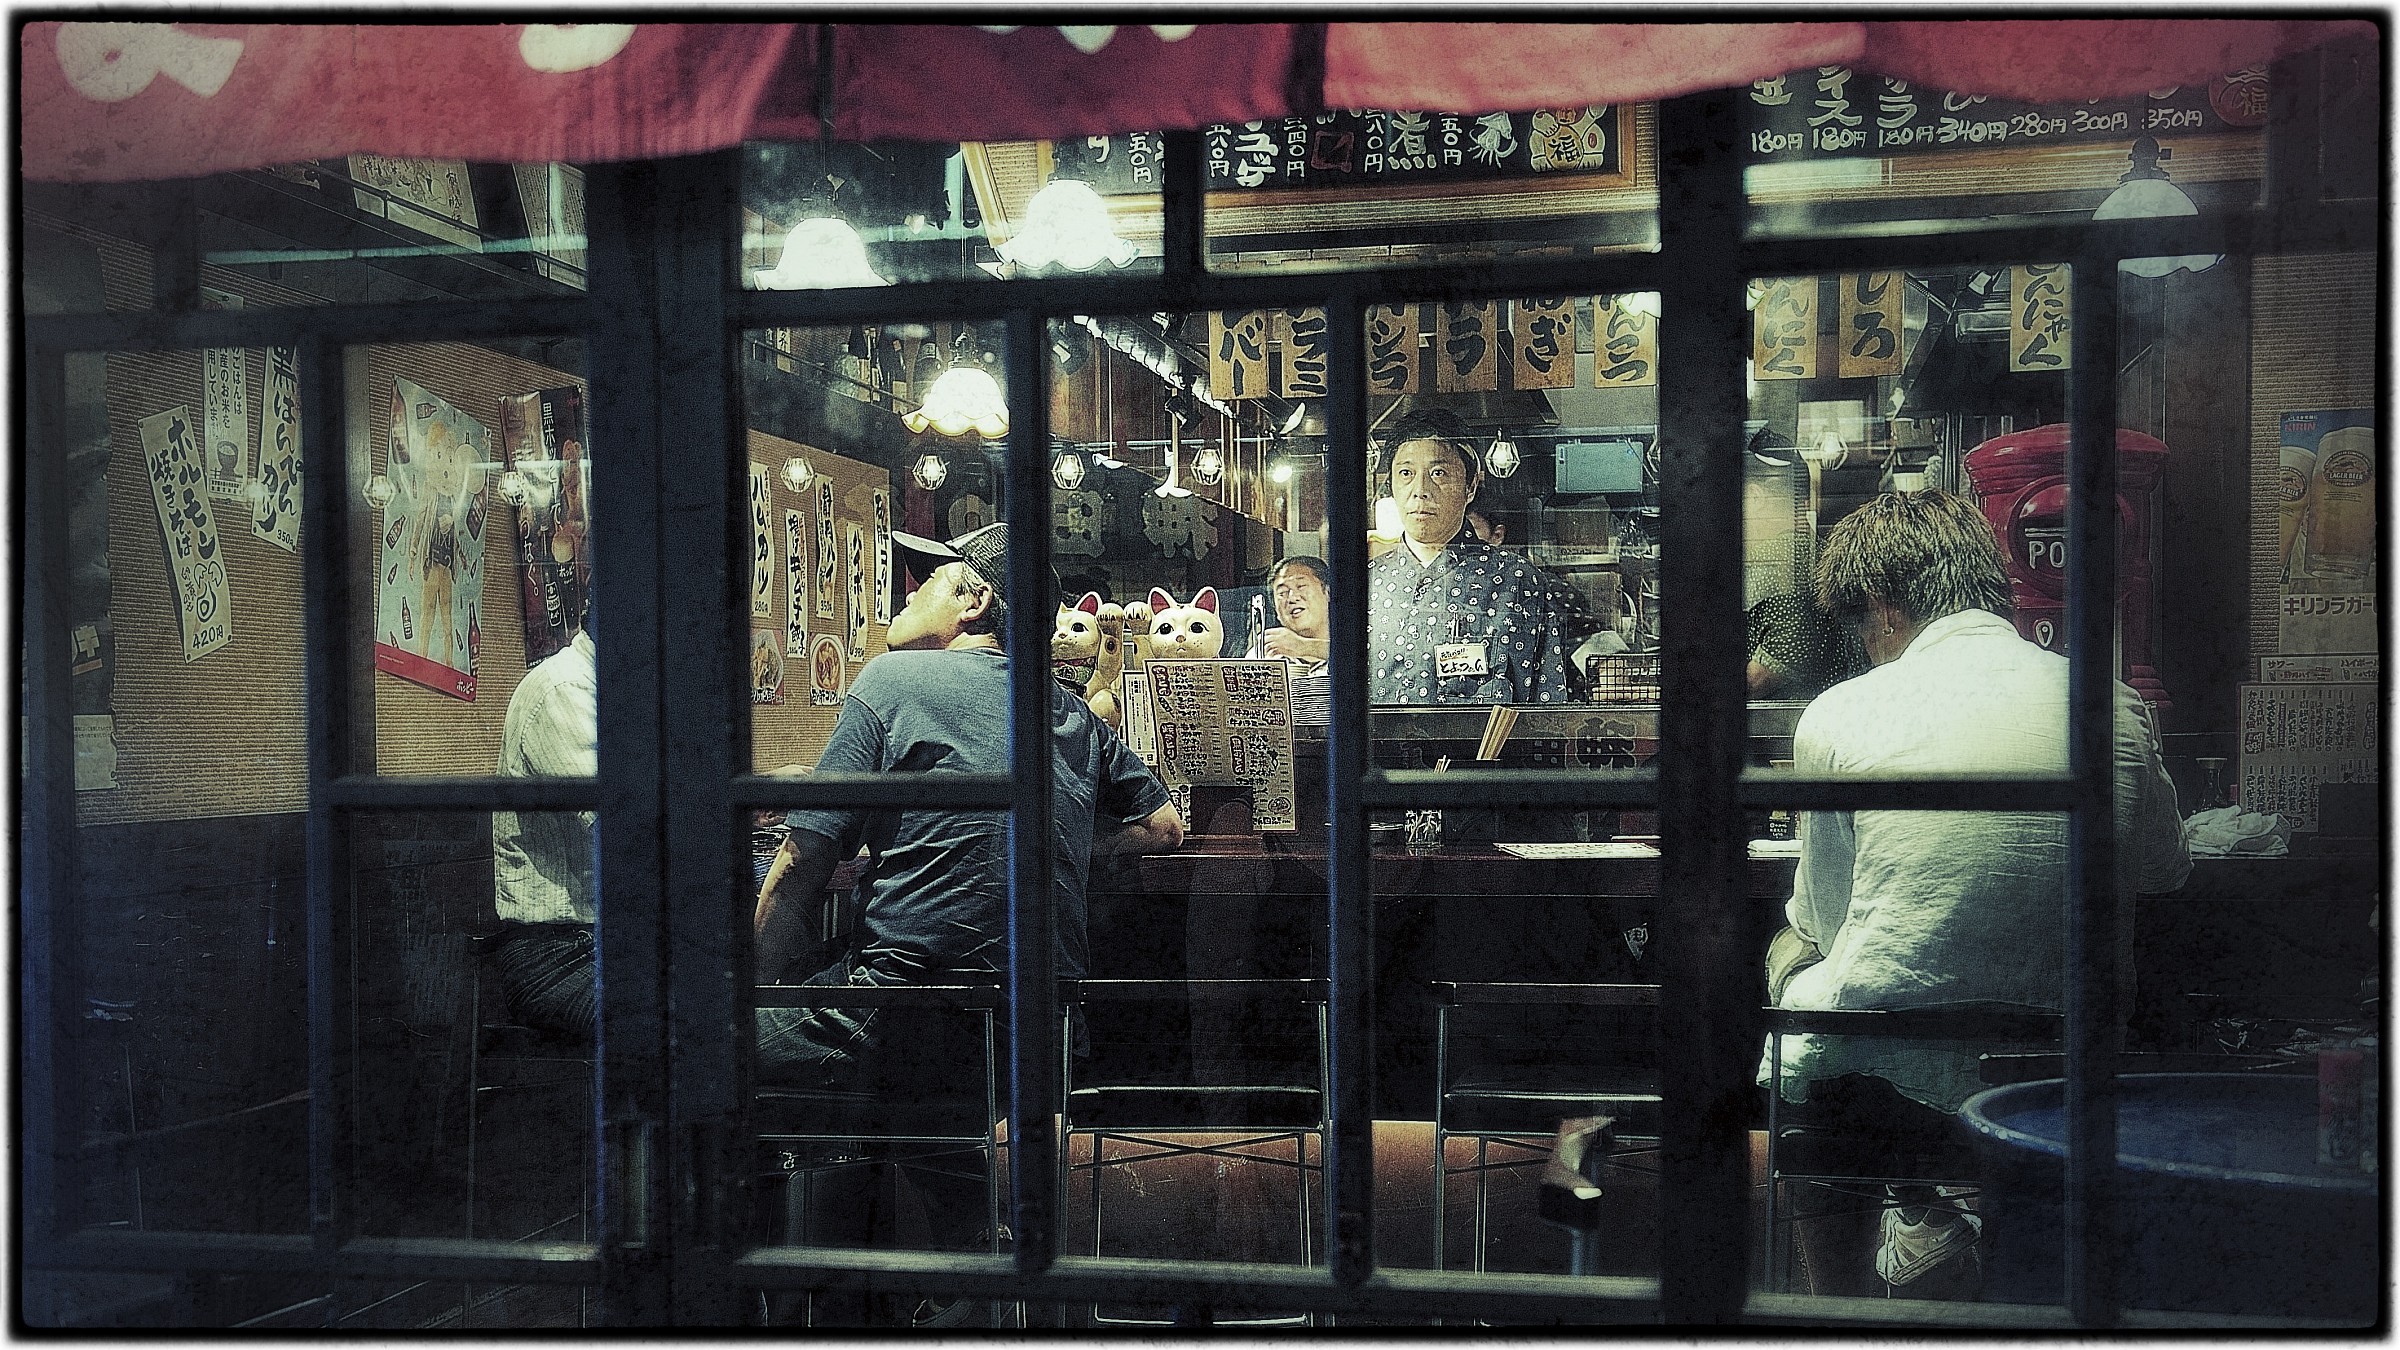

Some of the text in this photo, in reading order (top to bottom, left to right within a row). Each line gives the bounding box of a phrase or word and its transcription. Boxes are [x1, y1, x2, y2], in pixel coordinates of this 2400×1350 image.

[1876, 77, 1918, 128] ラ
[2071, 109, 2128, 133] 300円
[1439, 111, 1462, 165] 五〇円
[1752, 129, 1804, 153] 180円
[1813, 127, 1867, 151] 180円
[1878, 125, 1934, 149] 180円
[1937, 117, 2008, 143] 340円
[2009, 112, 2067, 138] 280円
[1128, 131, 1152, 183] 五〇円
[1549, 134, 1580, 163] 福
[1443, 300, 1487, 376] ラ
[1599, 296, 1649, 382] んこつ
[1762, 276, 1809, 376] んにく
[1287, 308, 1328, 394] ラミ
[1370, 304, 1409, 390] シラ
[2284, 422, 2317, 433] KIRIN
[150, 448, 192, 560] 焼きそば
[167, 415, 217, 560] ホルモン
[192, 625, 224, 650] 420円
[2267, 660, 2295, 669] サワー
